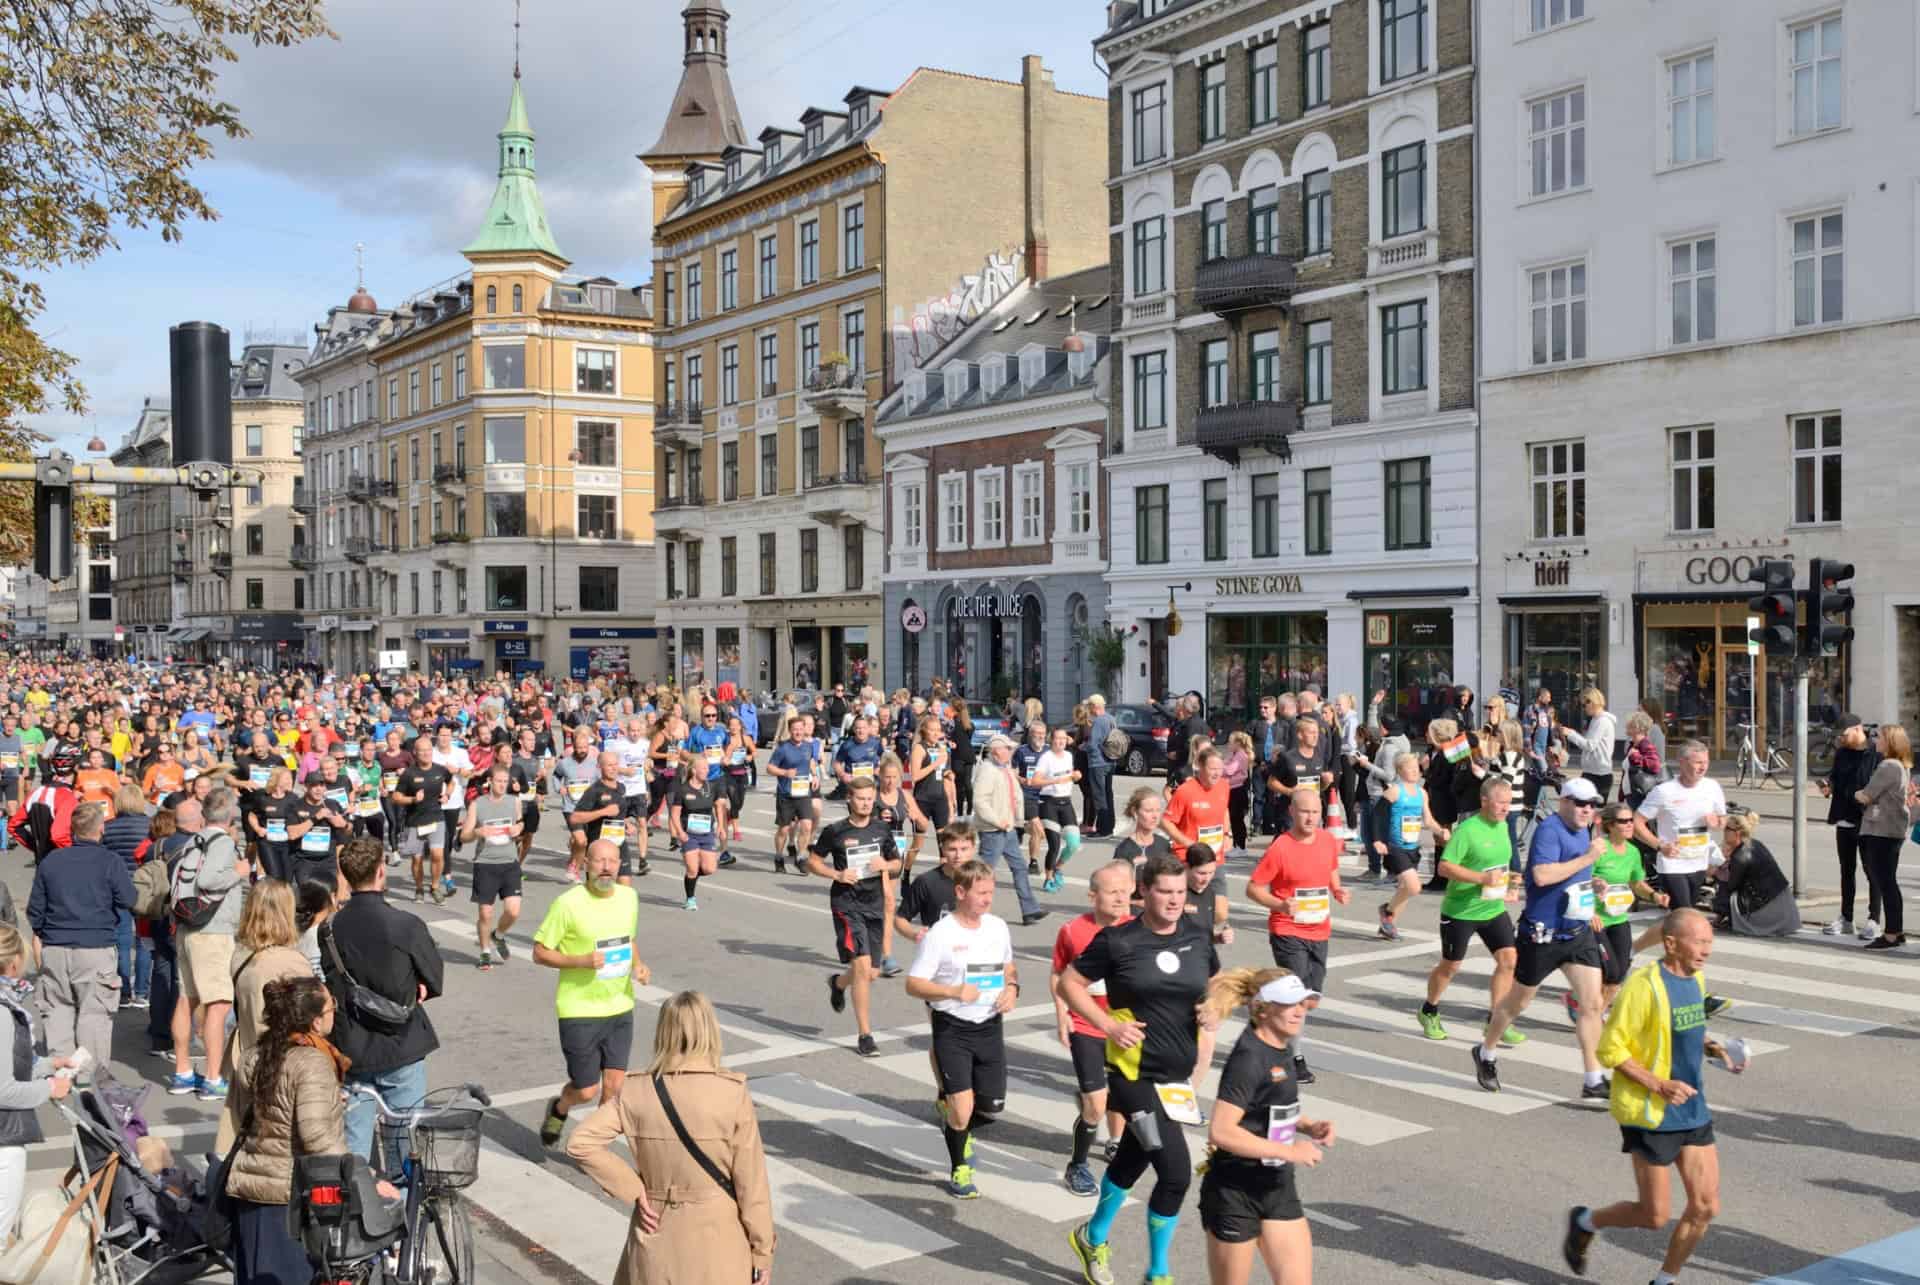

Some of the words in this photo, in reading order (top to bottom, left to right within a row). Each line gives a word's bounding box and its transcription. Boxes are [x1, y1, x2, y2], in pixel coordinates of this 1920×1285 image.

[1686, 554, 1795, 585] GOO
[1216, 575, 1260, 595] STINE
[1263, 575, 1302, 593] GOYA
[952, 595, 969, 617] JOE
[975, 595, 993, 617] THE
[994, 593, 1021, 617] JUICE
